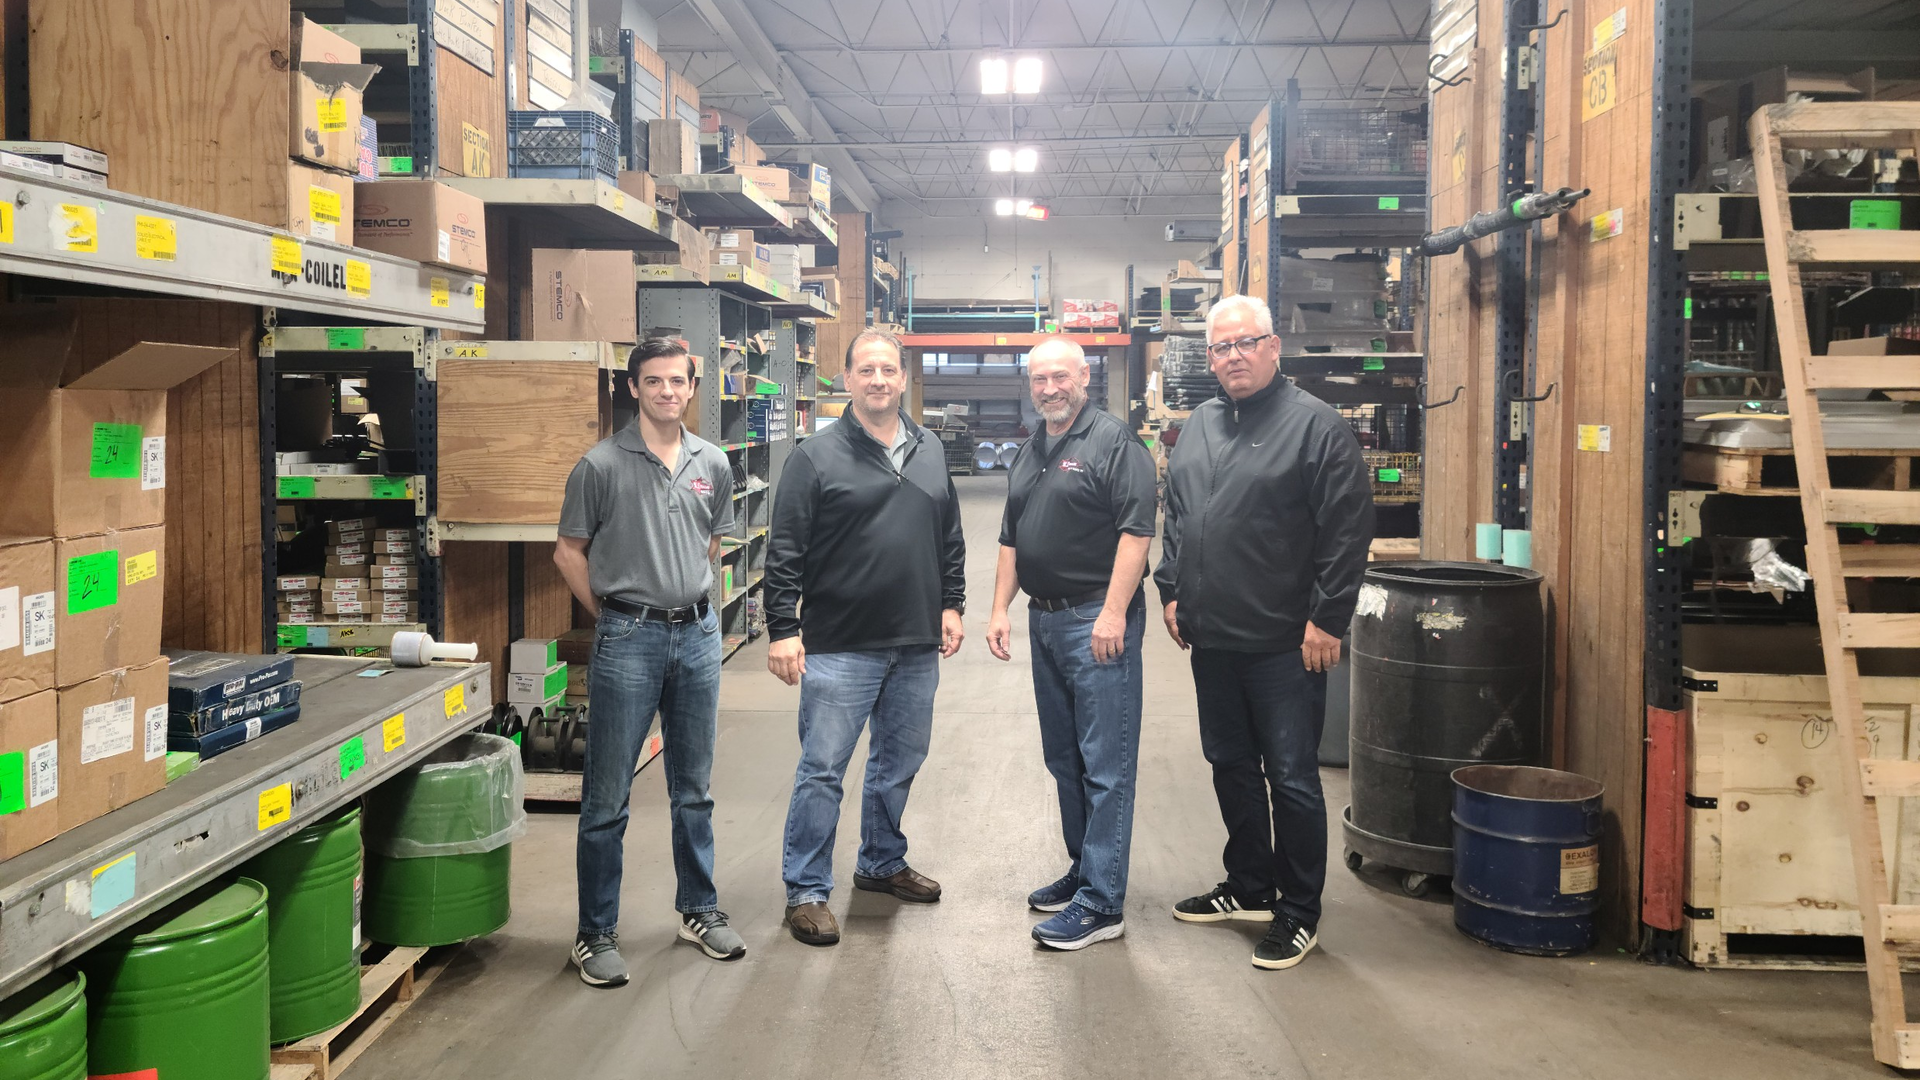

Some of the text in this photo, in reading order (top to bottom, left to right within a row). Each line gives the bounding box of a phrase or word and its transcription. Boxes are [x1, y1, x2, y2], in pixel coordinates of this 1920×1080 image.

[1589, 69, 1607, 109] CB
[463, 128, 488, 151] SECTION
[471, 149, 486, 177] AK
[353, 218, 411, 228] TEMCO
[452, 225, 476, 238] STEMCO
[105, 445, 118, 464] 24
[150, 452, 159, 461] SK
[82, 572, 100, 599] 24
[35, 610, 45, 621] SK
[222, 692, 280, 721] Heavy Duty OEM
[154, 721, 162, 730] SK
[1811, 721, 1823, 740] 14
[40, 760, 49, 771] SK
